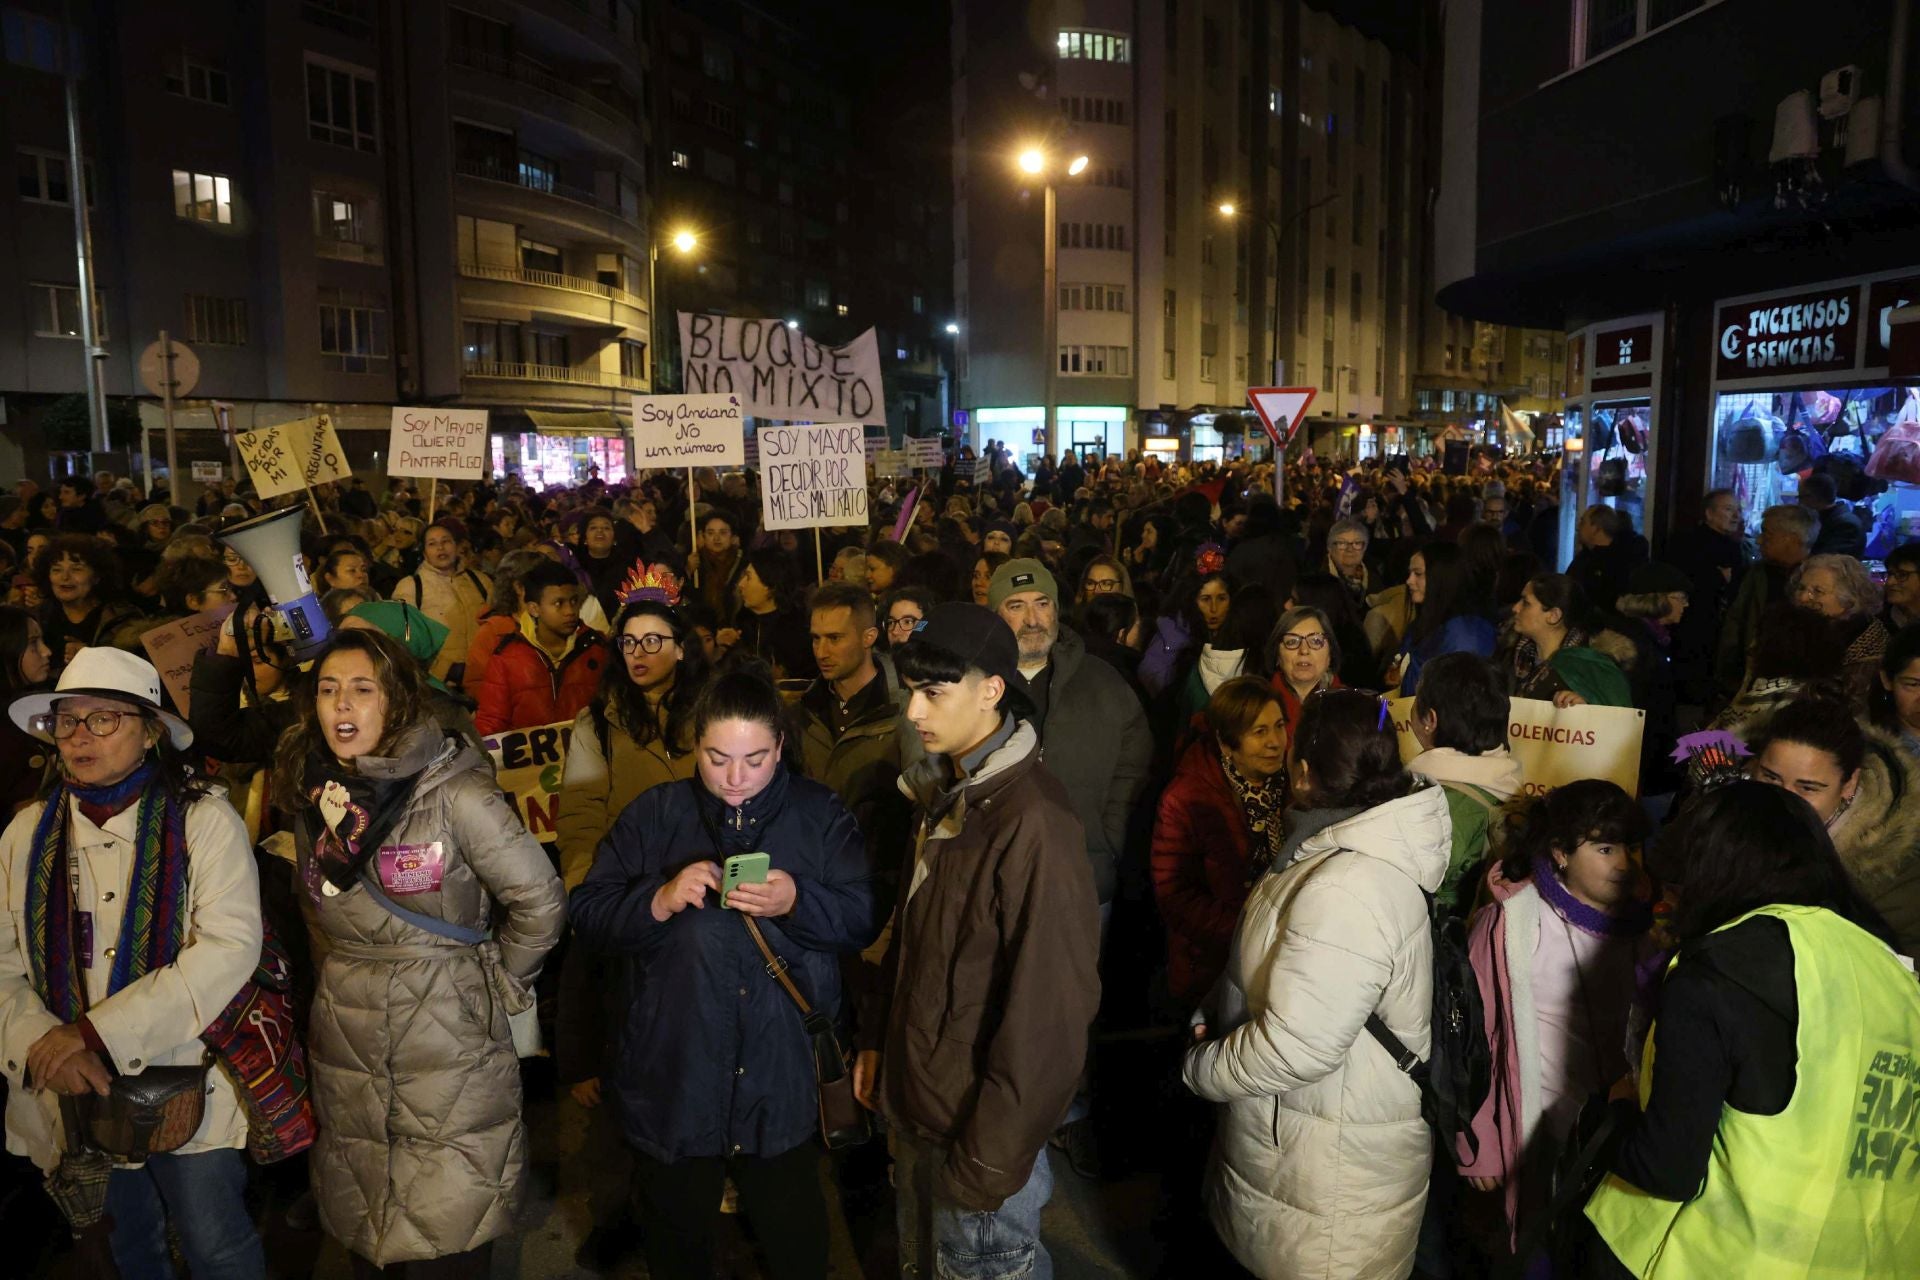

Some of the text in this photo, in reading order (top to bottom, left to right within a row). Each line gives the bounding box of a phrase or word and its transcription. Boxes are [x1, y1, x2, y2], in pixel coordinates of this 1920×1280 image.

[1748, 296, 1850, 337] INCIENSOS
[690, 313, 854, 376] BLOQUE
[1746, 332, 1836, 368] ESENCIAS
[685, 360, 733, 394] NO
[642, 404, 674, 427] Soy
[239, 432, 257, 452] NO
[248, 428, 280, 473] DECIDAS
[645, 443, 725, 457] un número
[763, 429, 800, 457] SOY
[808, 427, 862, 456] MAYOR
[262, 447, 285, 474] POR
[449, 452, 482, 469] ALGO
[826, 458, 851, 487] POR
[810, 487, 867, 519] MALTRATO
[350, 815, 366, 841] LLUCA
